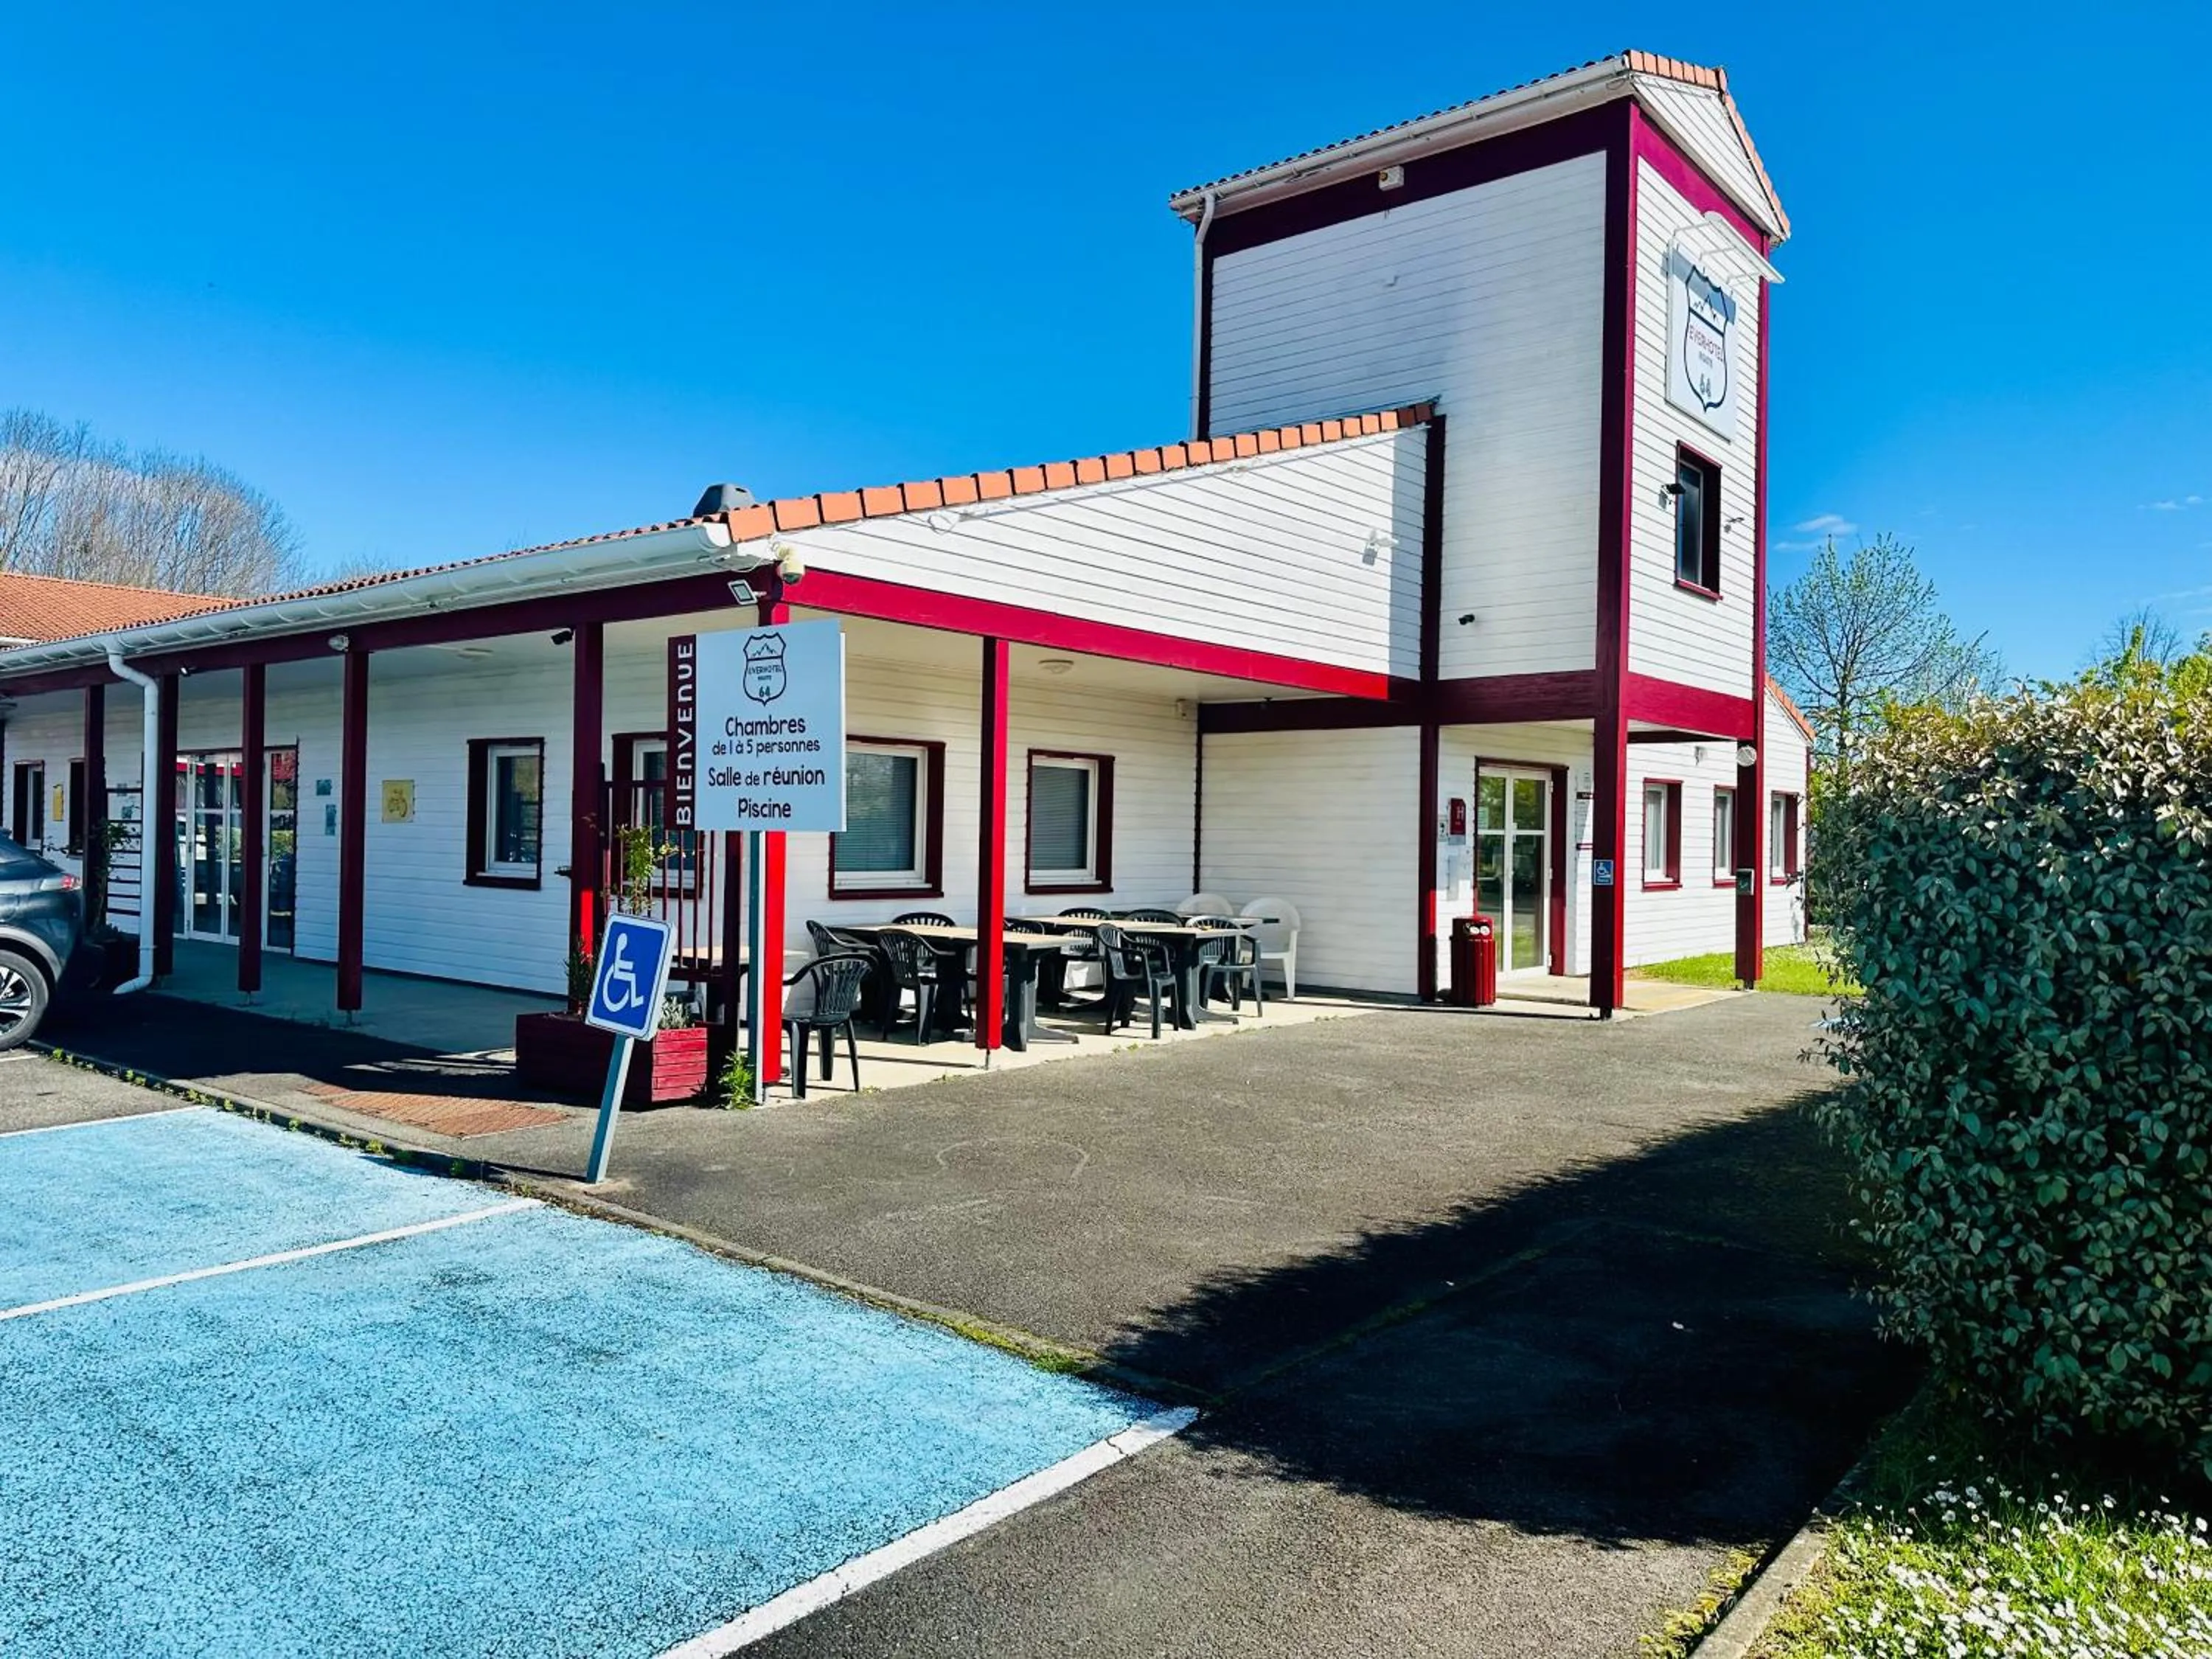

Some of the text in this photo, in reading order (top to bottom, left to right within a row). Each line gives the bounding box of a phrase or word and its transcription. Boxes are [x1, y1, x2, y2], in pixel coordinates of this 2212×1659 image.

[759, 686, 771, 698] 64
[725, 715, 806, 737] Chambres
[712, 740, 726, 756] de
[734, 739, 744, 754] à
[746, 740, 753, 753] 5
[757, 738, 821, 757] personnes
[708, 765, 825, 787] Salle de réunion
[738, 798, 791, 818] Piscine
